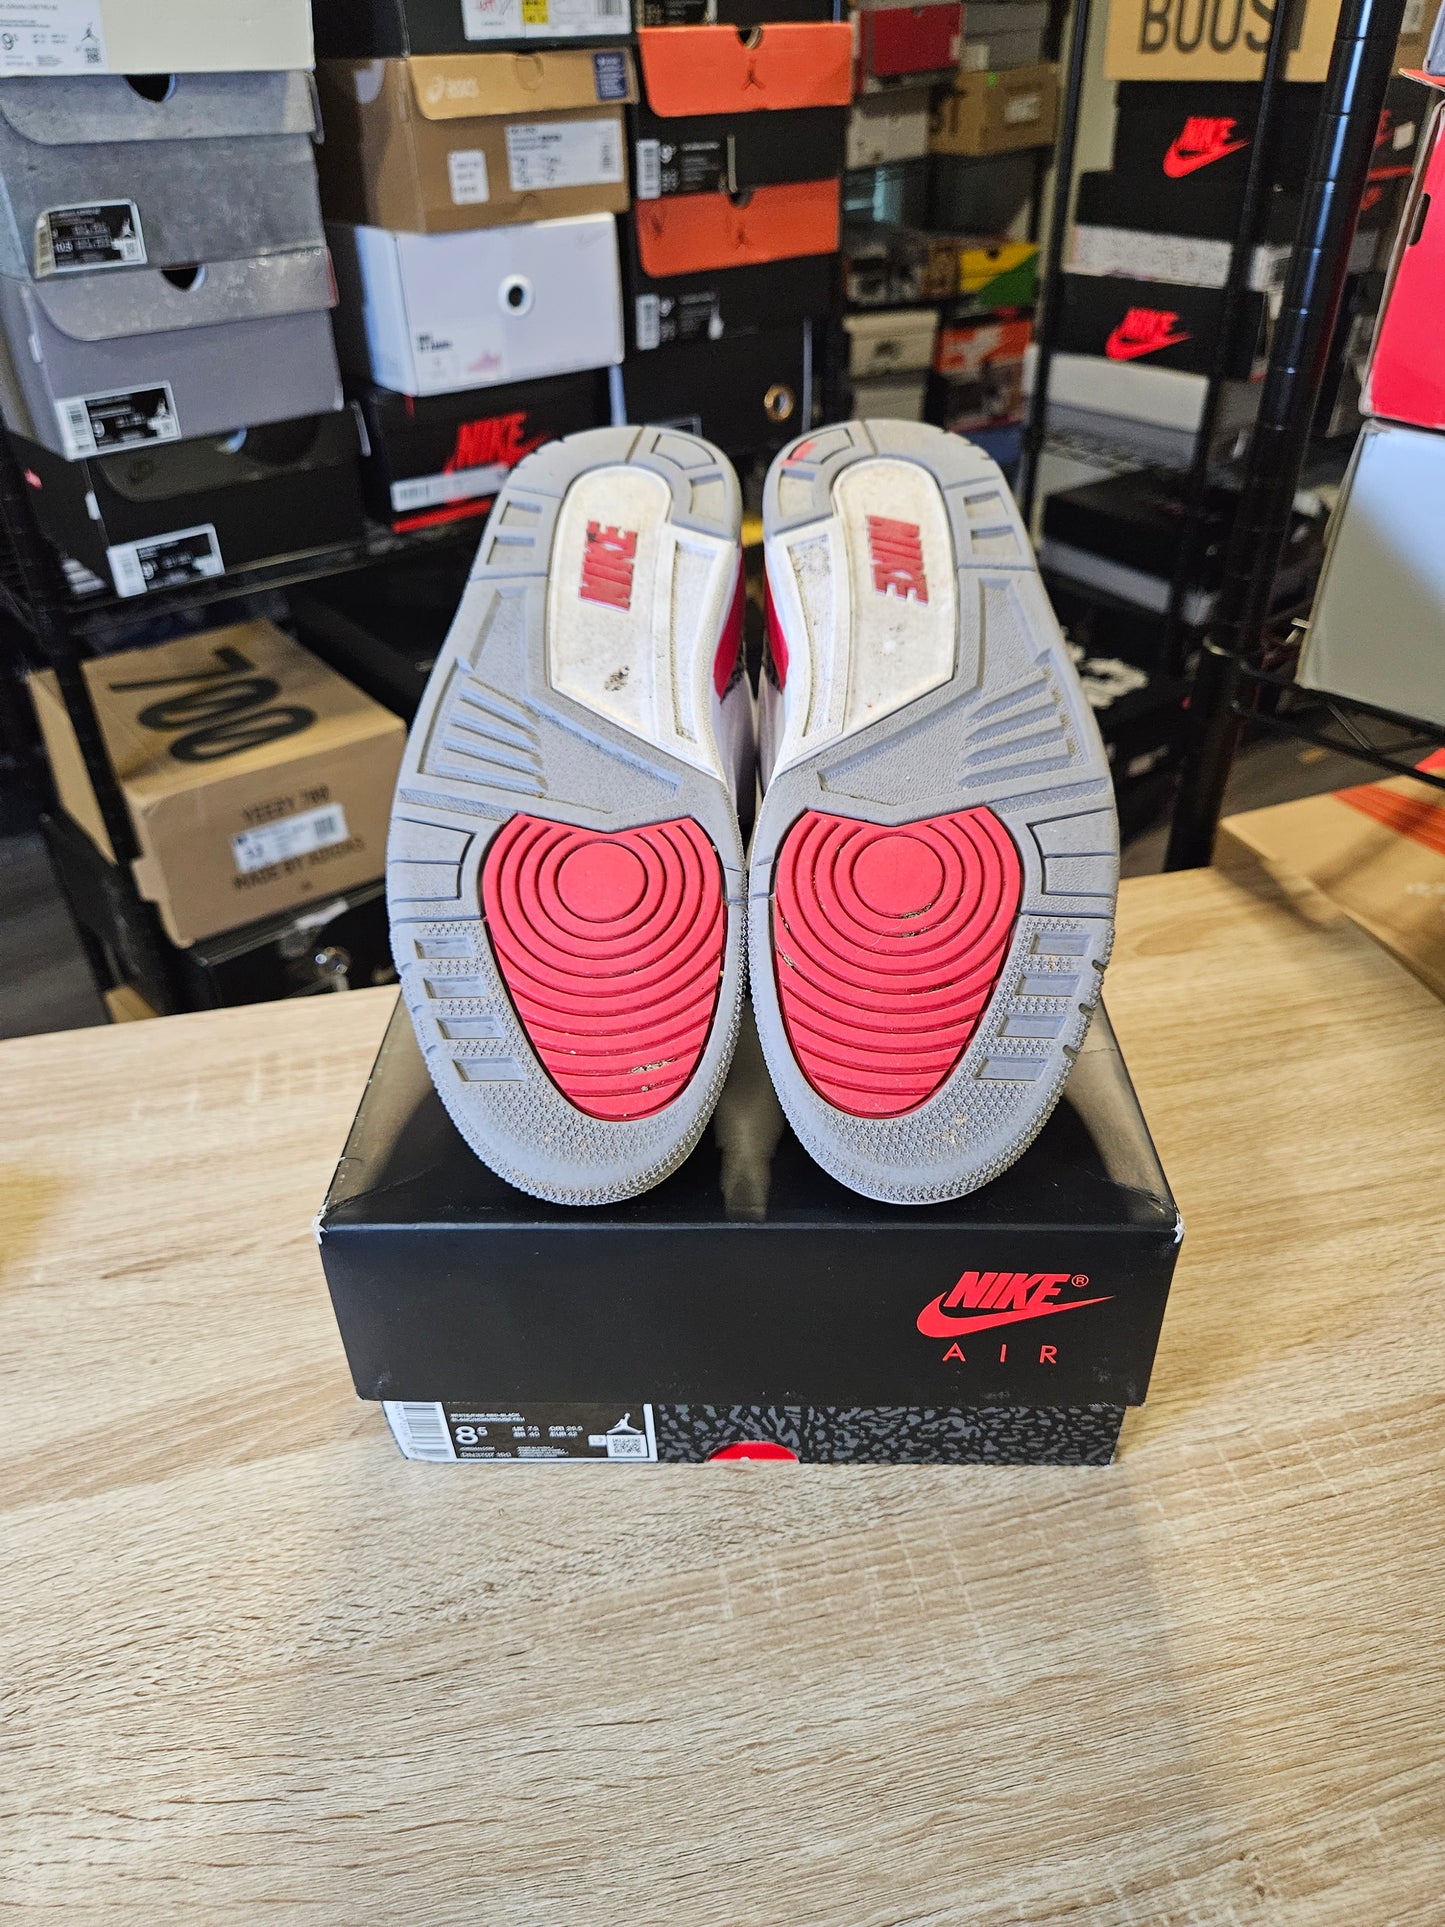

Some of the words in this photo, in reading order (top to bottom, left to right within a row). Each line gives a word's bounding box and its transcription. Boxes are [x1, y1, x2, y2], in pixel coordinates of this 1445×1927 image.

[456, 412, 527, 469] NIKE
[578, 519, 638, 612] NIKE
[868, 515, 930, 606] NIKE
[109, 646, 317, 762] 700
[942, 1342, 1058, 1364] AIR
